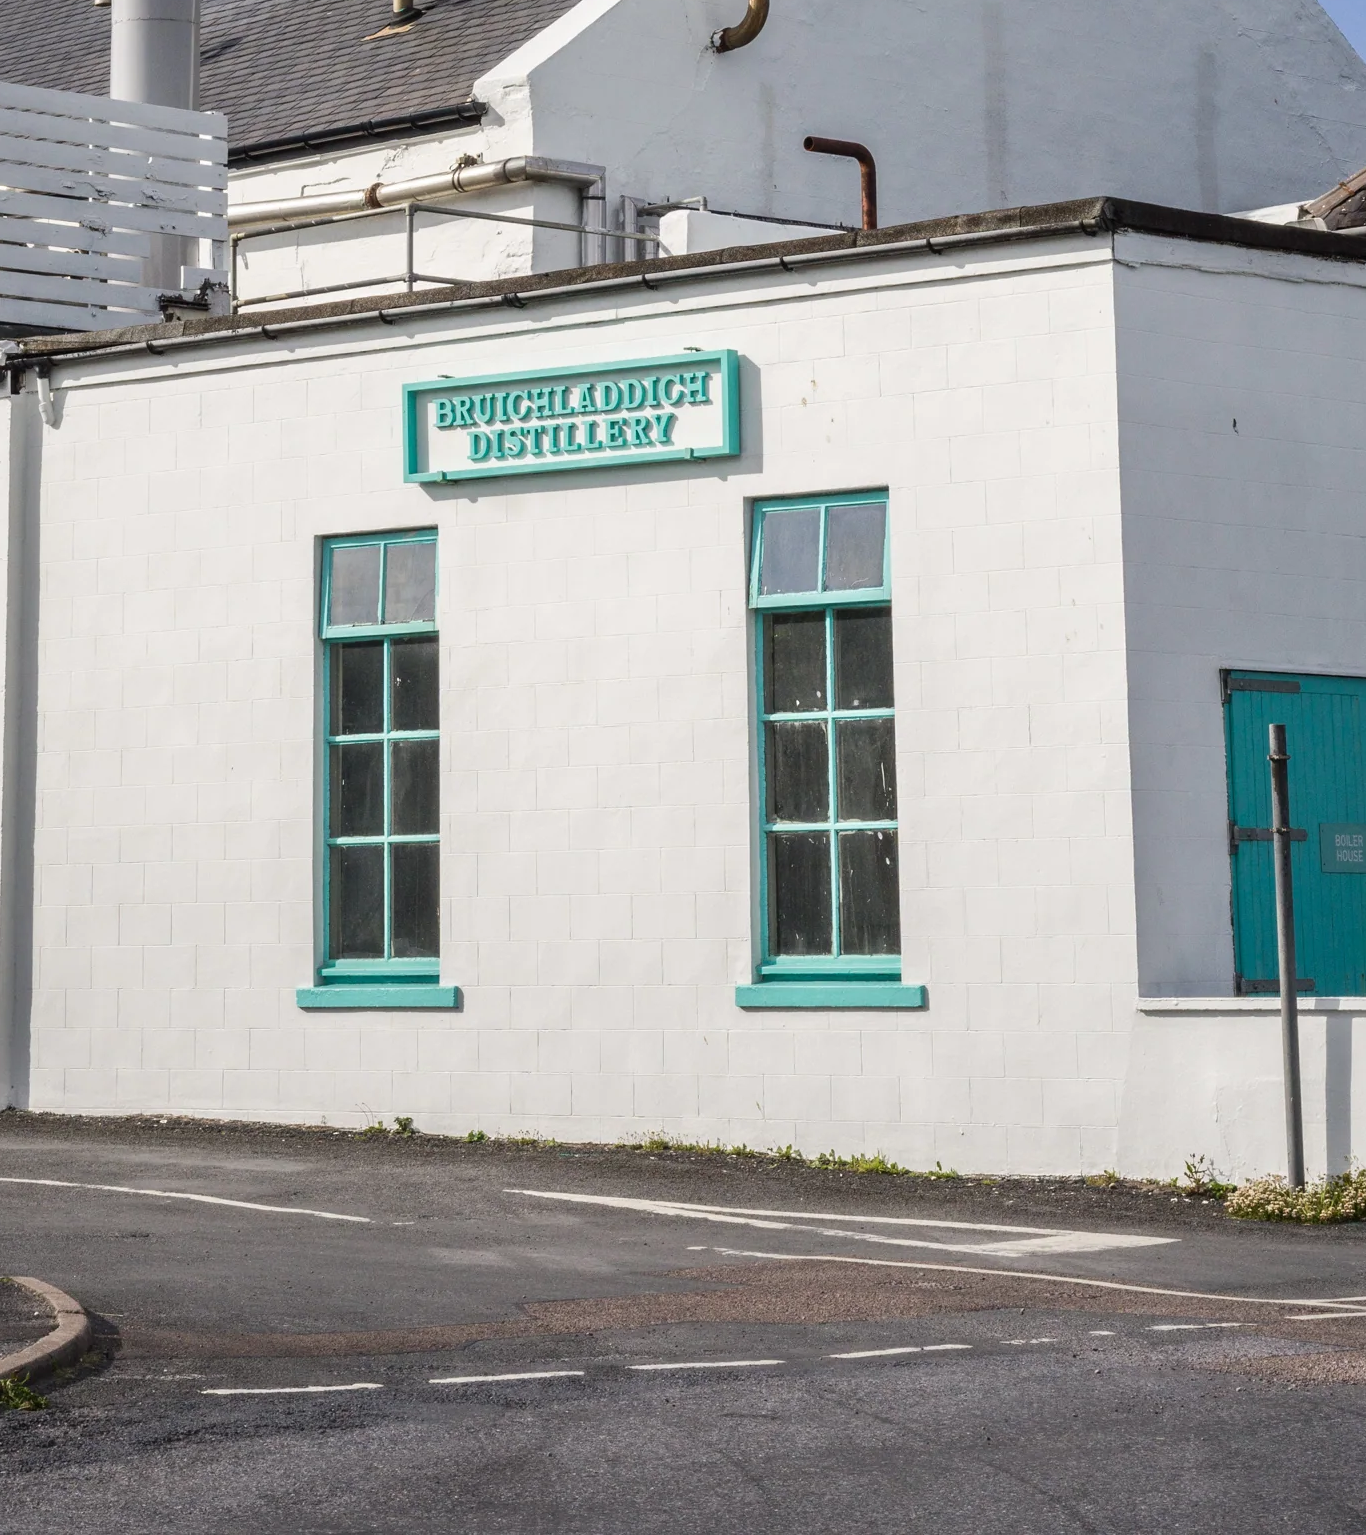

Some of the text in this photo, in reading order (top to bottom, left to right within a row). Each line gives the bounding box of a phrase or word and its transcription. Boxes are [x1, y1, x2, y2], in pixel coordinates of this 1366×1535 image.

[433, 371, 709, 428] BRUICHLADDICH
[467, 412, 676, 461] DISTILLERY
[1334, 834, 1364, 847] BOILER
[1336, 849, 1364, 862] HOUSE
